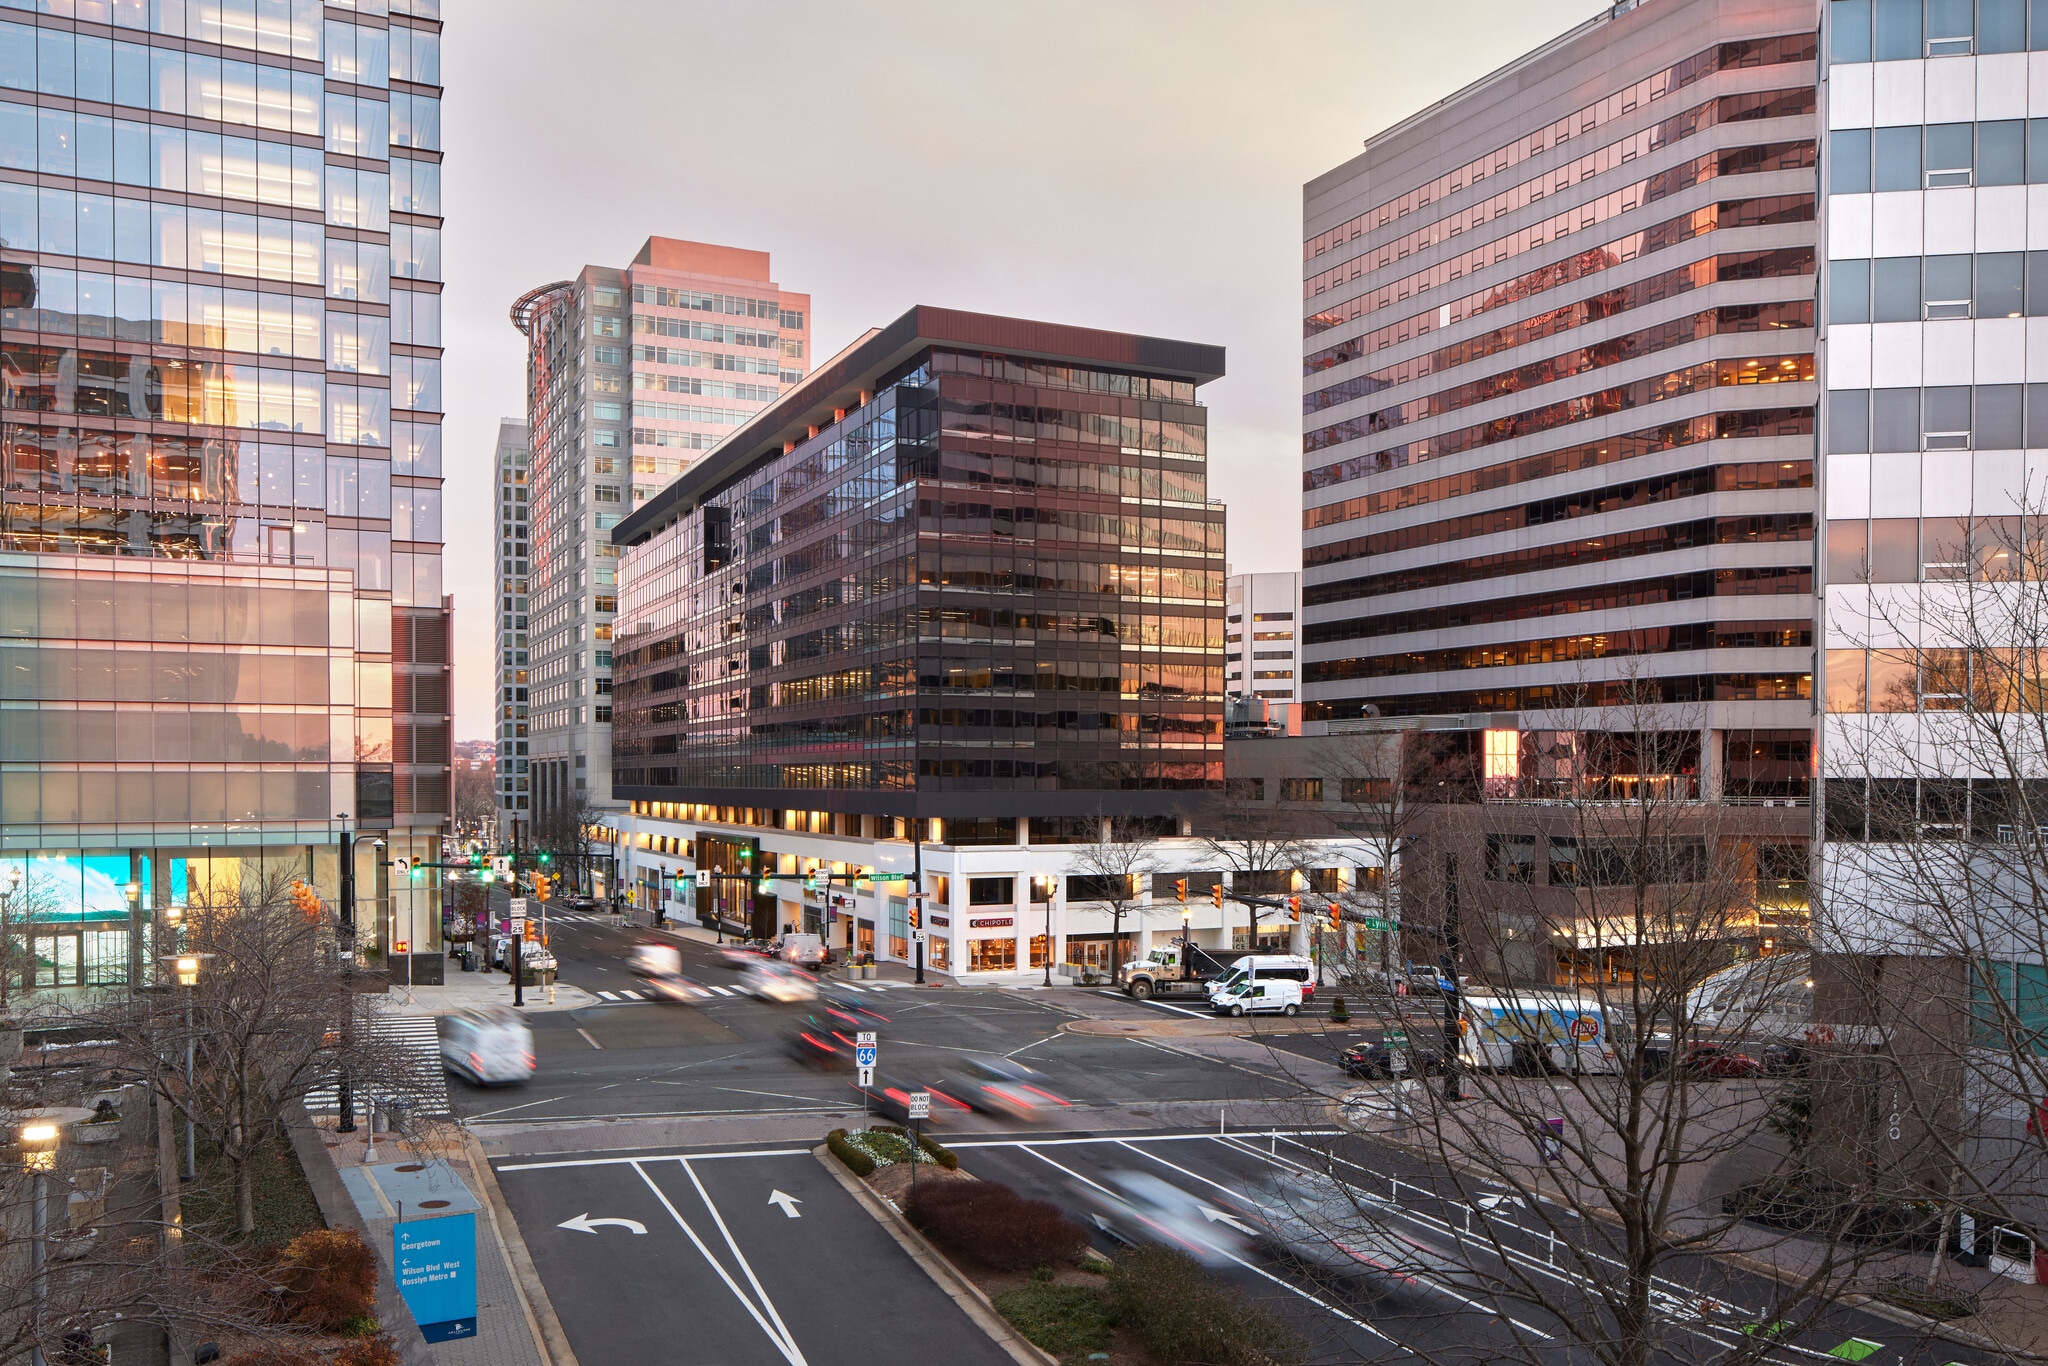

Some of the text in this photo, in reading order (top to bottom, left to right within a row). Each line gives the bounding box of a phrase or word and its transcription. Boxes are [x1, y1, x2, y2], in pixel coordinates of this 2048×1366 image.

[979, 919, 1013, 927] CHIPOTLE
[512, 926, 523, 934] 25
[863, 1033, 872, 1041] TO
[860, 1048, 874, 1062] 66
[402, 1239, 440, 1250] Georgetown
[402, 1261, 460, 1275] Wilson Blvd West
[402, 1273, 448, 1286] Rosslyn Metro
